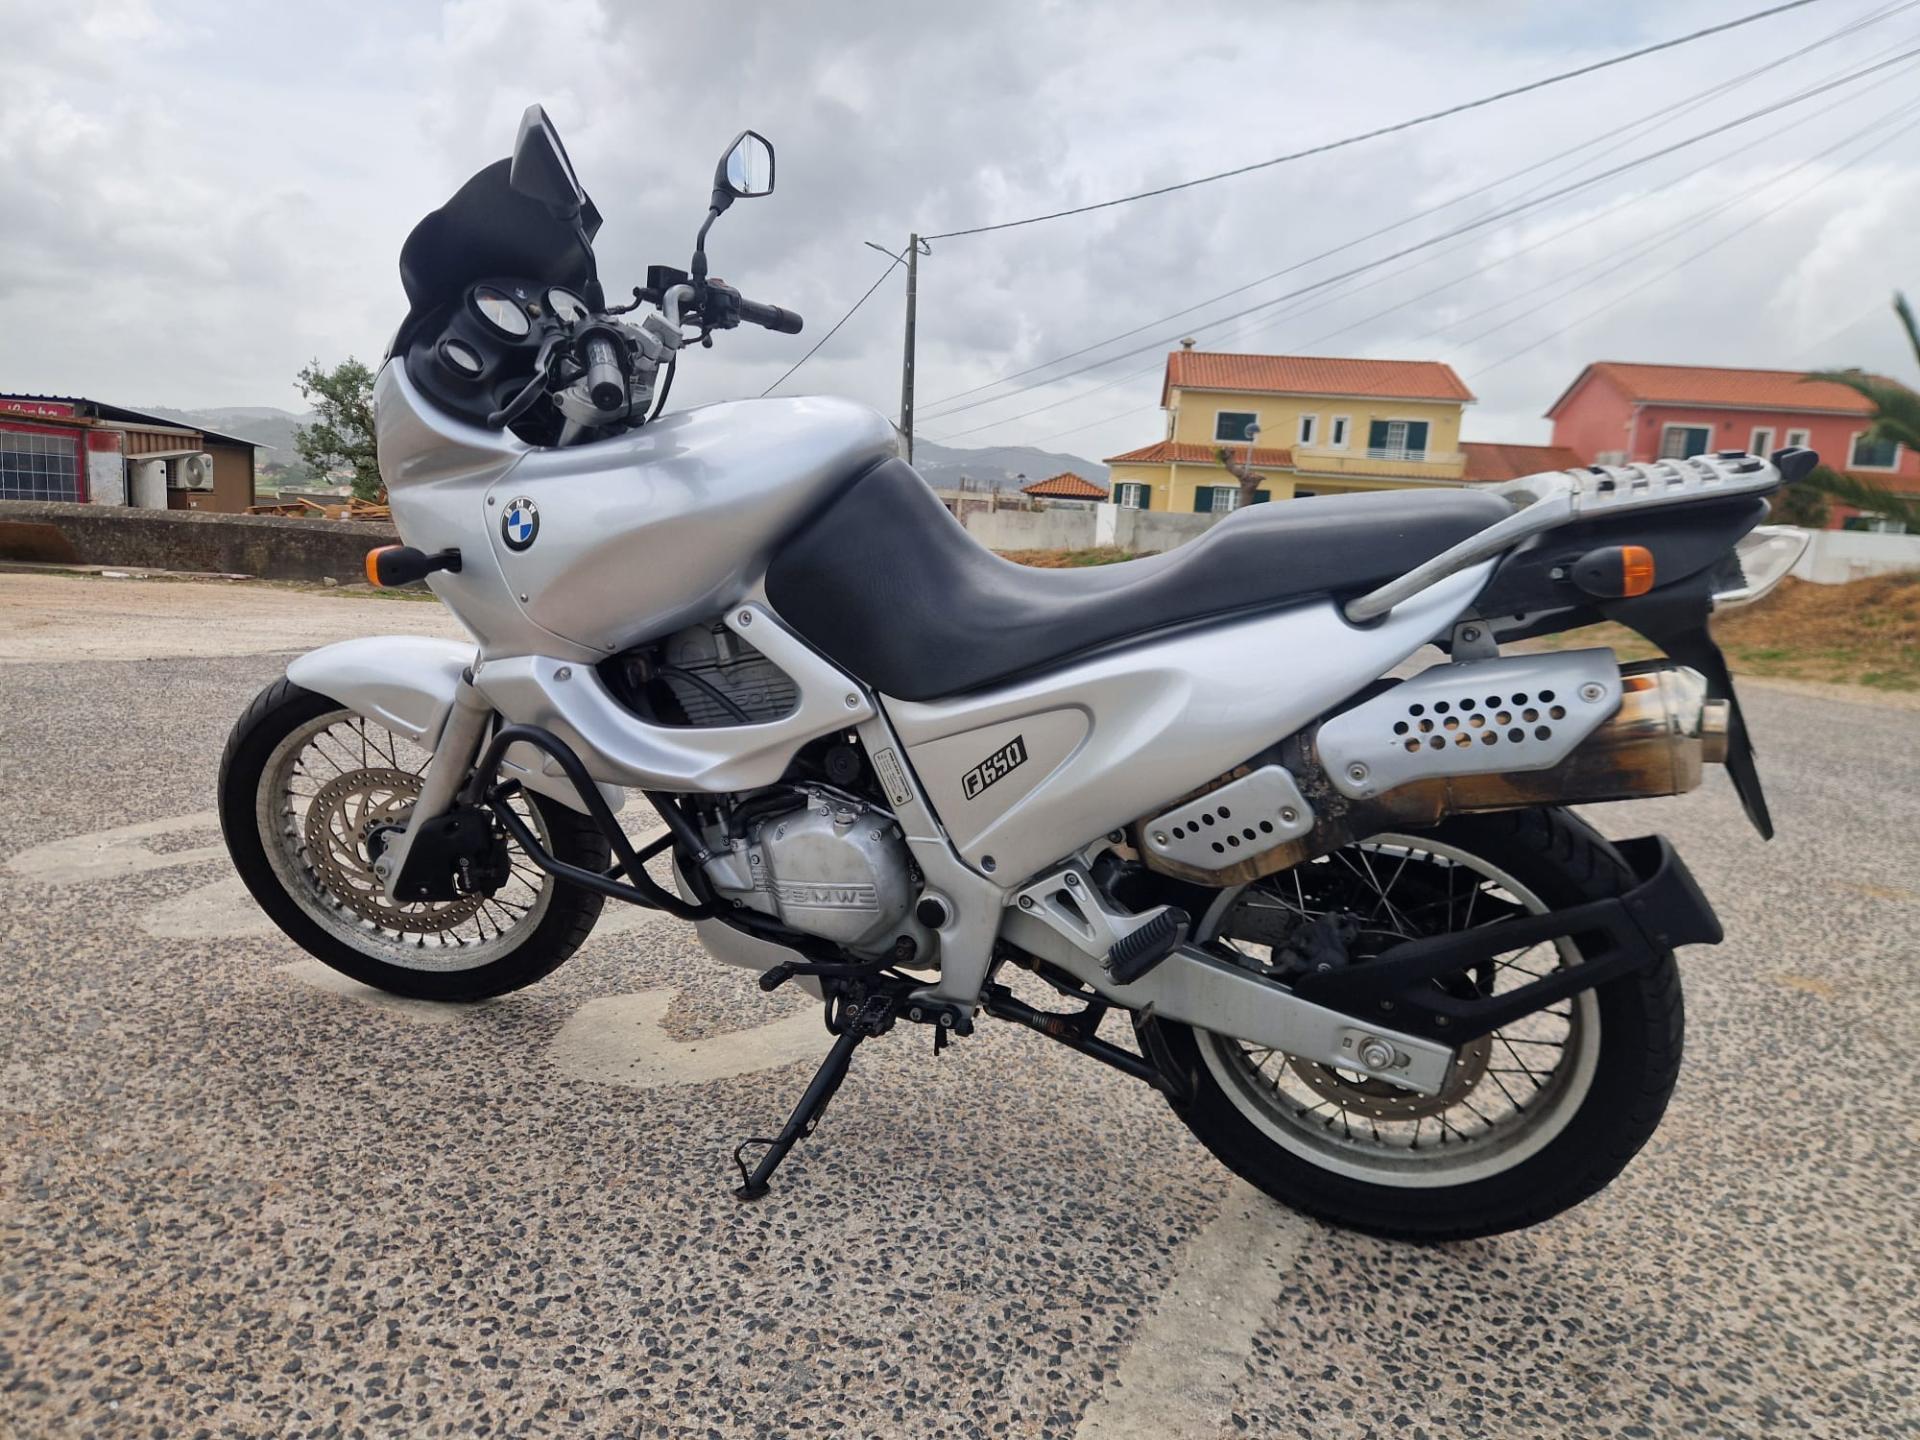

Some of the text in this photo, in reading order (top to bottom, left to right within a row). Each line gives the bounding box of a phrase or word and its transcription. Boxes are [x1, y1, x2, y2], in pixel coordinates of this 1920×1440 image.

[503, 499, 537, 518] BMW
[964, 739, 1022, 798] F650
[792, 887, 857, 904] BMW
